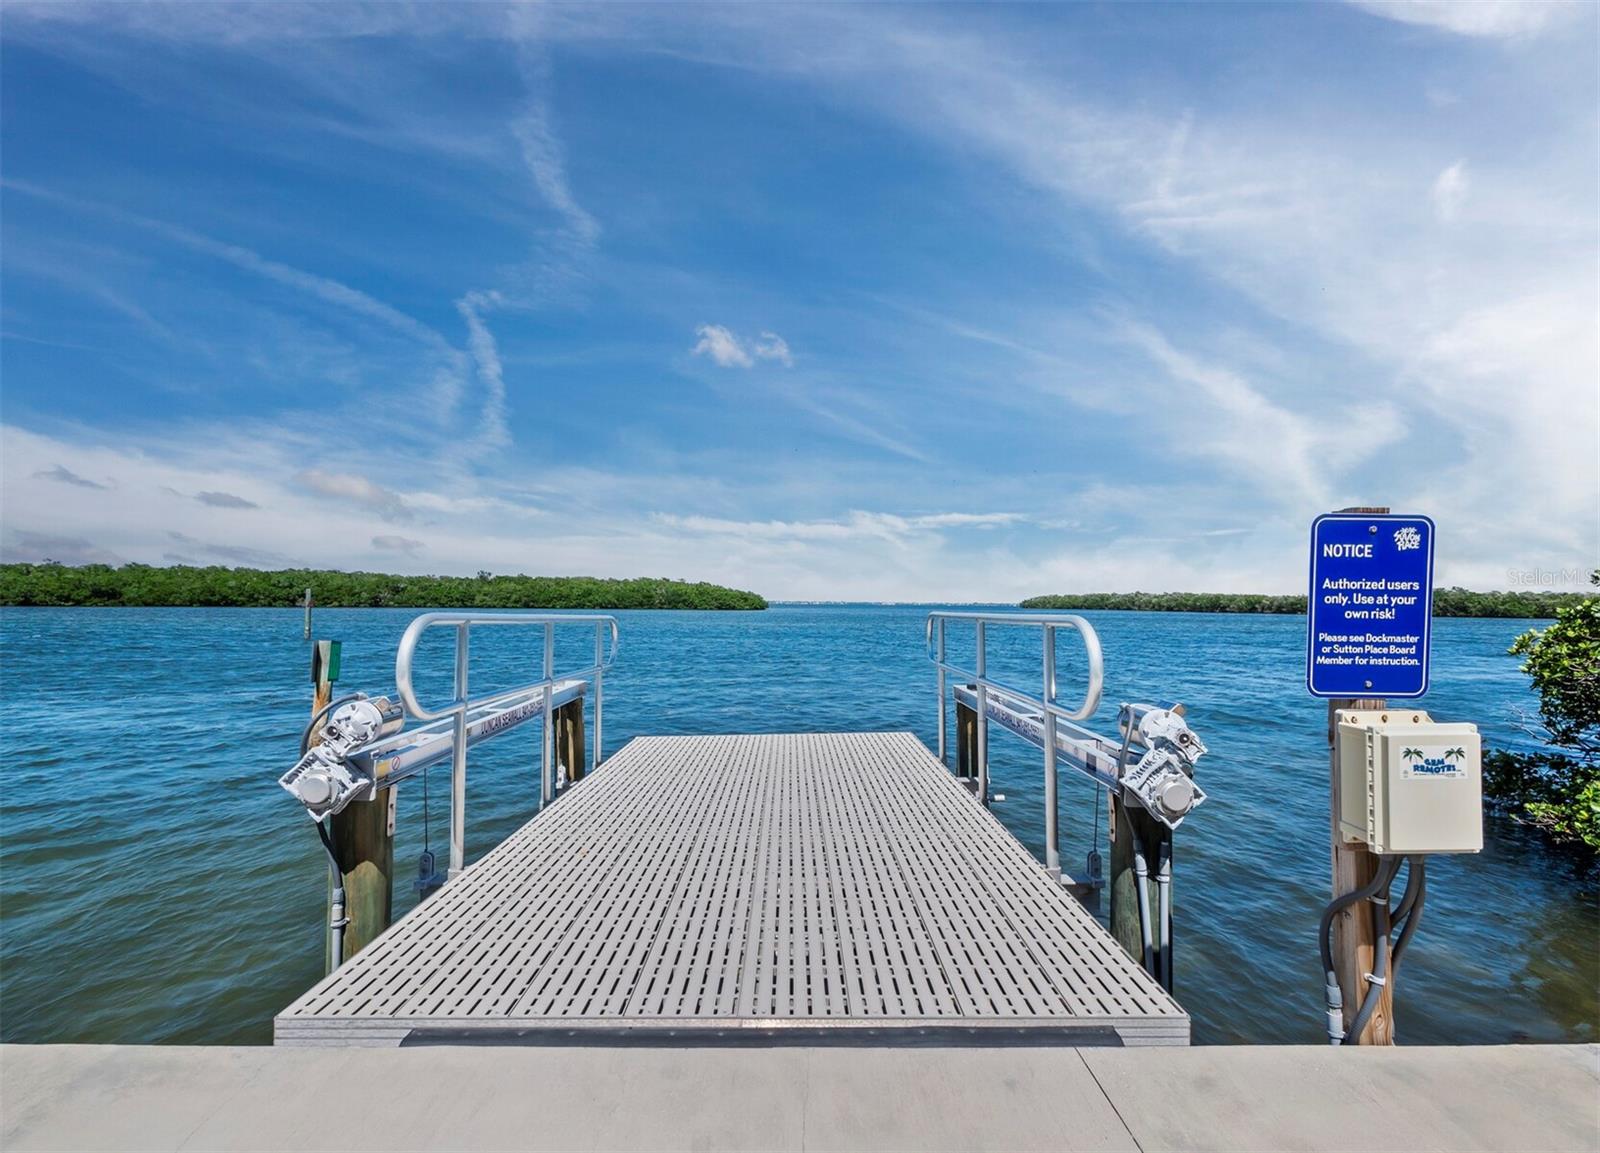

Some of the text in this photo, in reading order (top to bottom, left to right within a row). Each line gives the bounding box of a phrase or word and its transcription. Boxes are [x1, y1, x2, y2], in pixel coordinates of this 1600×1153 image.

[1323, 544, 1373, 558] NOTICE
[1322, 578, 1420, 590] Authorized users
[1324, 593, 1417, 607] only. Use at your
[1344, 608, 1395, 619] own risk!
[1318, 632, 1420, 643] Please see Dockmaster
[1333, 644, 1363, 654] Sutton
[1364, 645, 1388, 654] Place
[1389, 645, 1416, 655] Board
[1316, 656, 1420, 666] Member for instruction.
